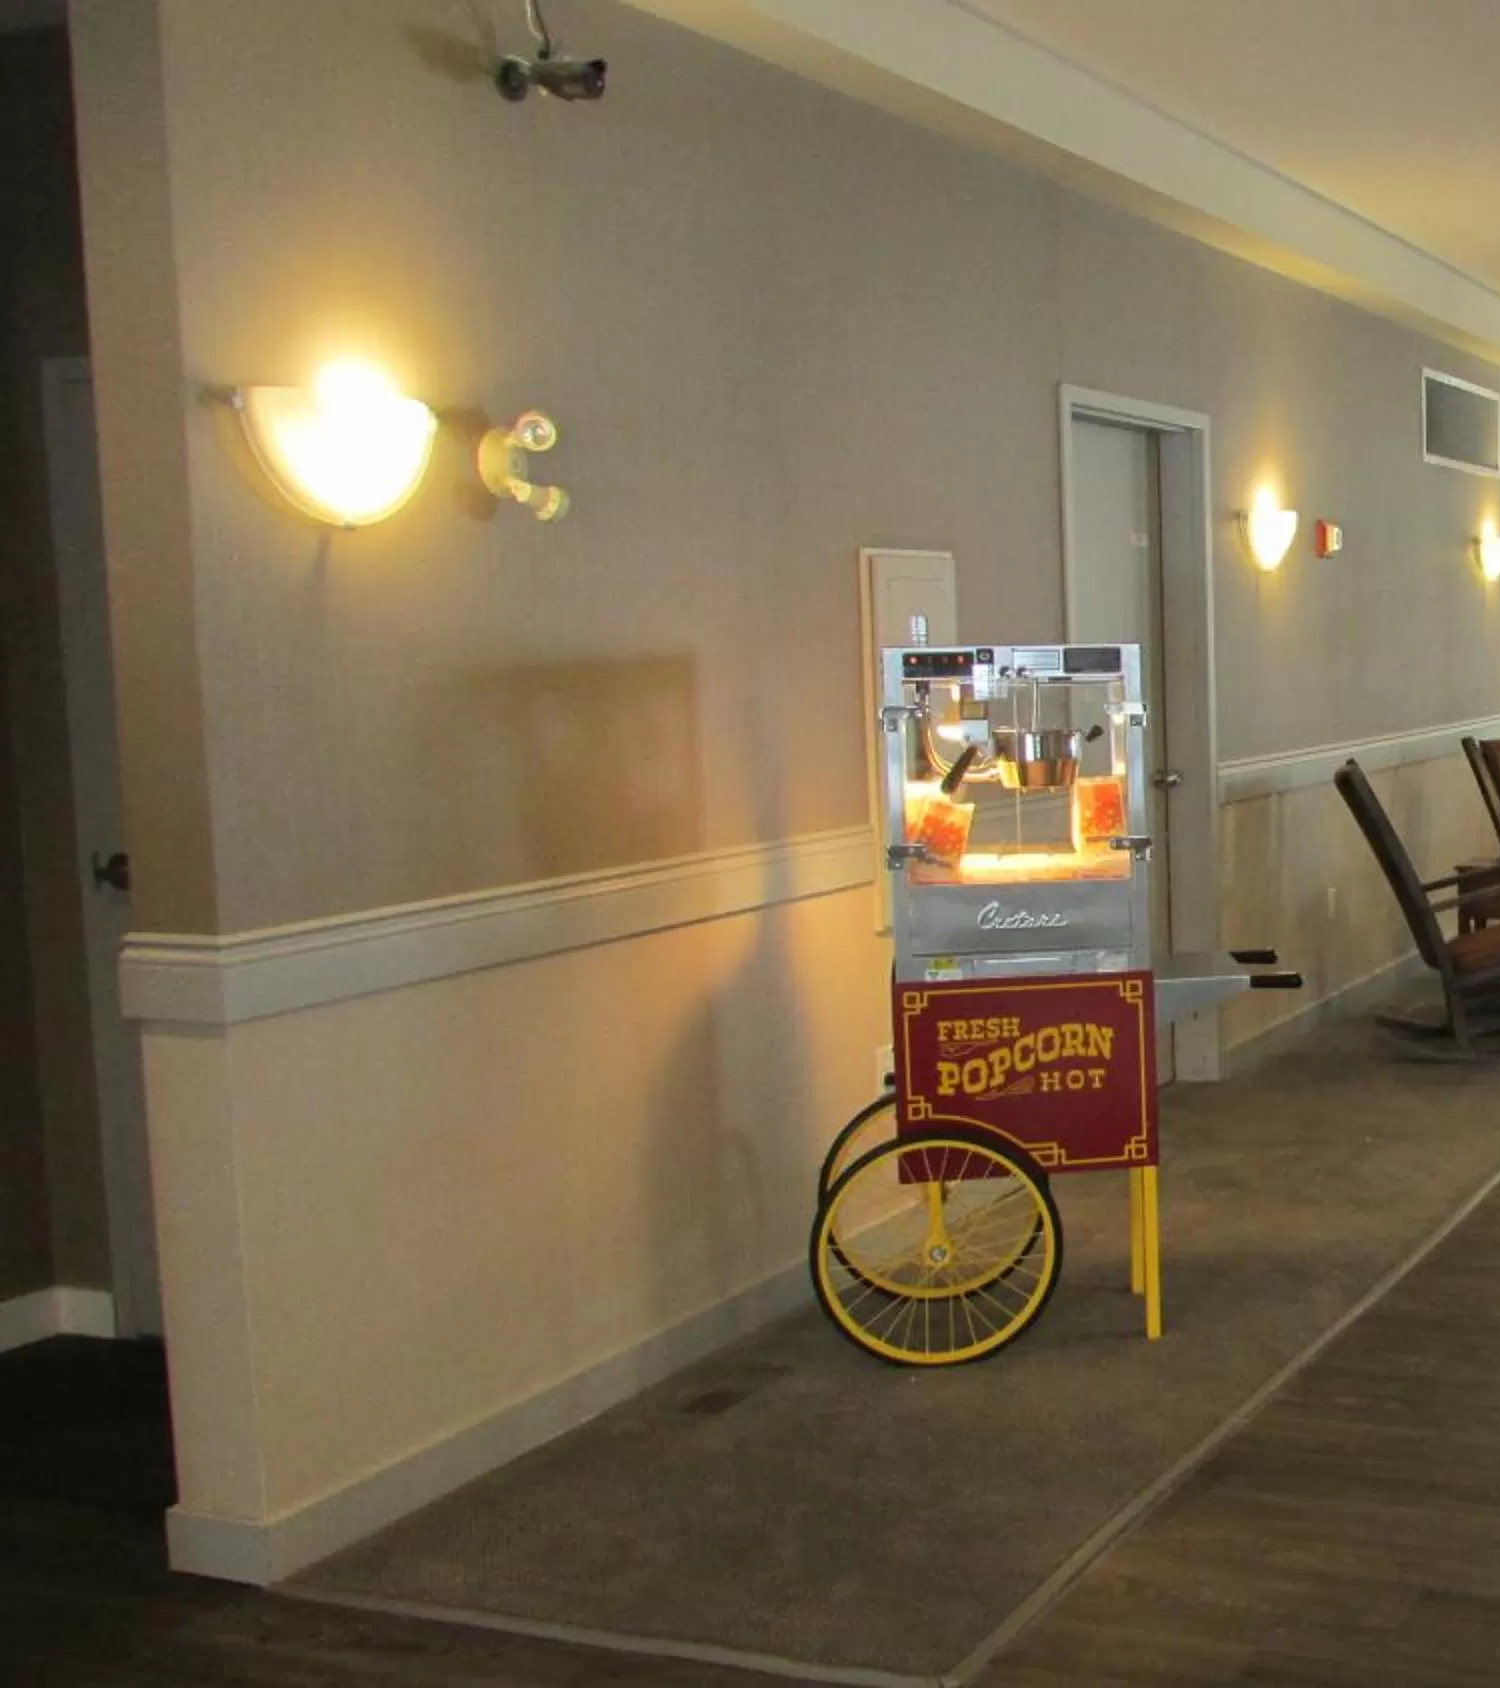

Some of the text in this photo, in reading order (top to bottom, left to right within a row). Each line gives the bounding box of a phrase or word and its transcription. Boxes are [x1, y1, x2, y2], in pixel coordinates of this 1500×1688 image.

[936, 1017, 1021, 1041] FRESH
[936, 1023, 1115, 1096] POPCORN
[1039, 1068, 1106, 1093] HOT
